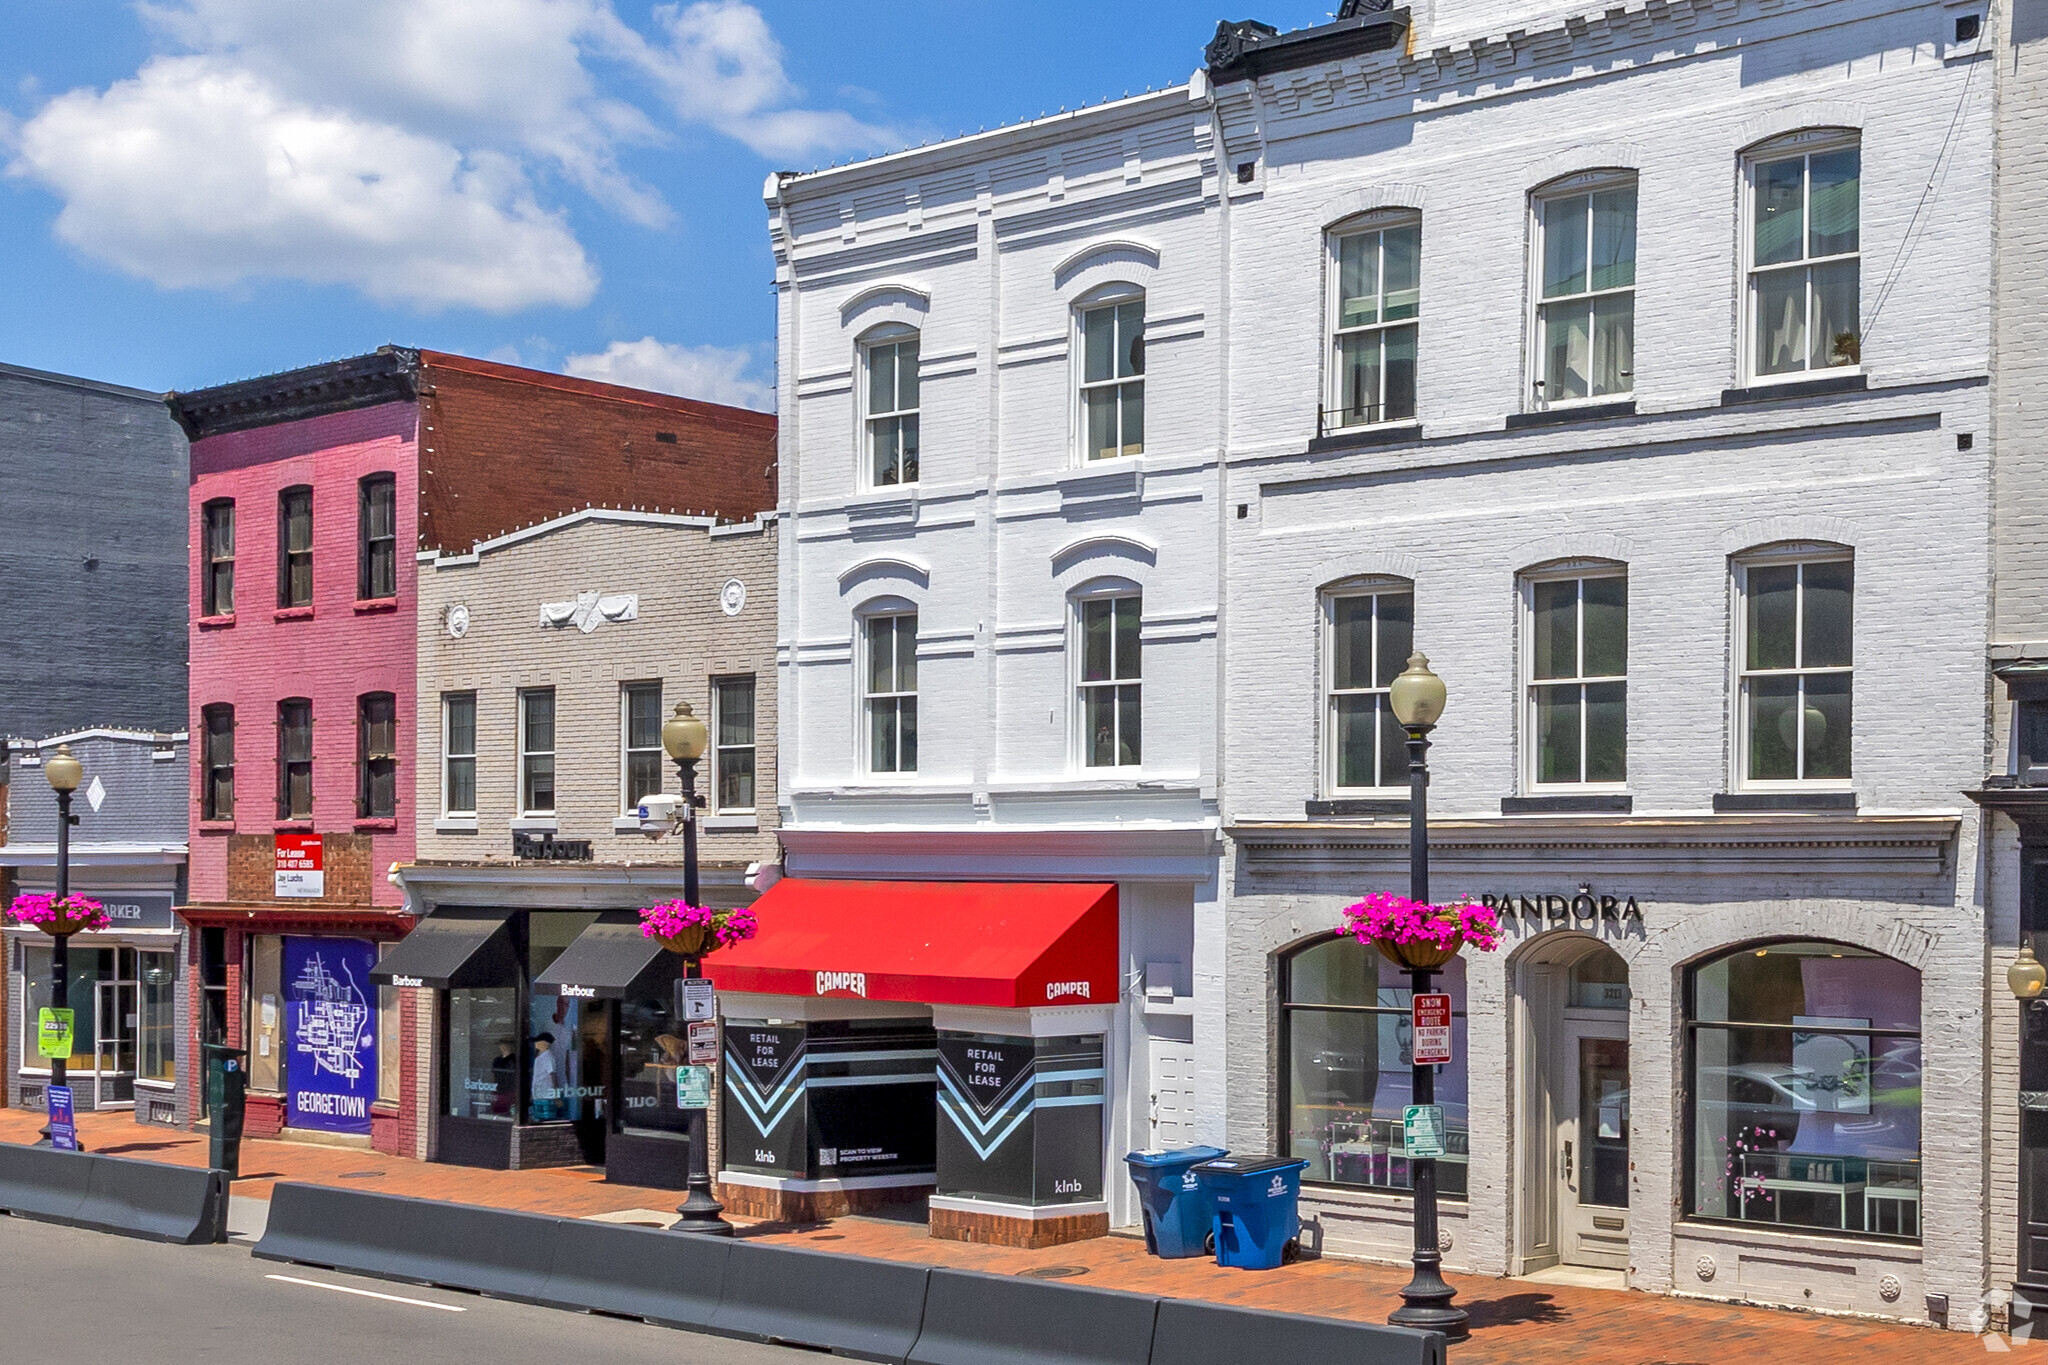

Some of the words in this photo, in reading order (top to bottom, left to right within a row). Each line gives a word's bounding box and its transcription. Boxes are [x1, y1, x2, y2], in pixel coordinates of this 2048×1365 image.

[277, 849, 287, 858] For
[287, 849, 306, 858] Lease
[103, 904, 142, 919] ARKER
[1481, 893, 1643, 921] PANDORA
[392, 974, 423, 987] Barbour
[816, 971, 866, 998] CAMPER
[561, 983, 596, 998] Barbour
[1046, 981, 1091, 1000] CAMPER
[1421, 998, 1442, 1008] SNOW
[1421, 1016, 1442, 1026] ROUTE
[750, 1034, 780, 1044] RETAIL
[1418, 1029, 1425, 1037] NO
[1426, 1028, 1447, 1037] PARKING
[1421, 1038, 1442, 1047] DURING
[756, 1046, 774, 1055] FOR
[967, 1049, 1004, 1062] RETAIL
[1417, 1048, 1448, 1057] EMERGENCY
[751, 1058, 779, 1068] LEASE
[974, 1062, 996, 1073] FOR
[464, 1078, 498, 1091] Barbour
[968, 1075, 1002, 1087] LEASE
[542, 1083, 606, 1099] arbour
[297, 1091, 365, 1118] GEORGETOWN
[754, 1149, 776, 1164] klnb
[1055, 1178, 1082, 1194] klnb
